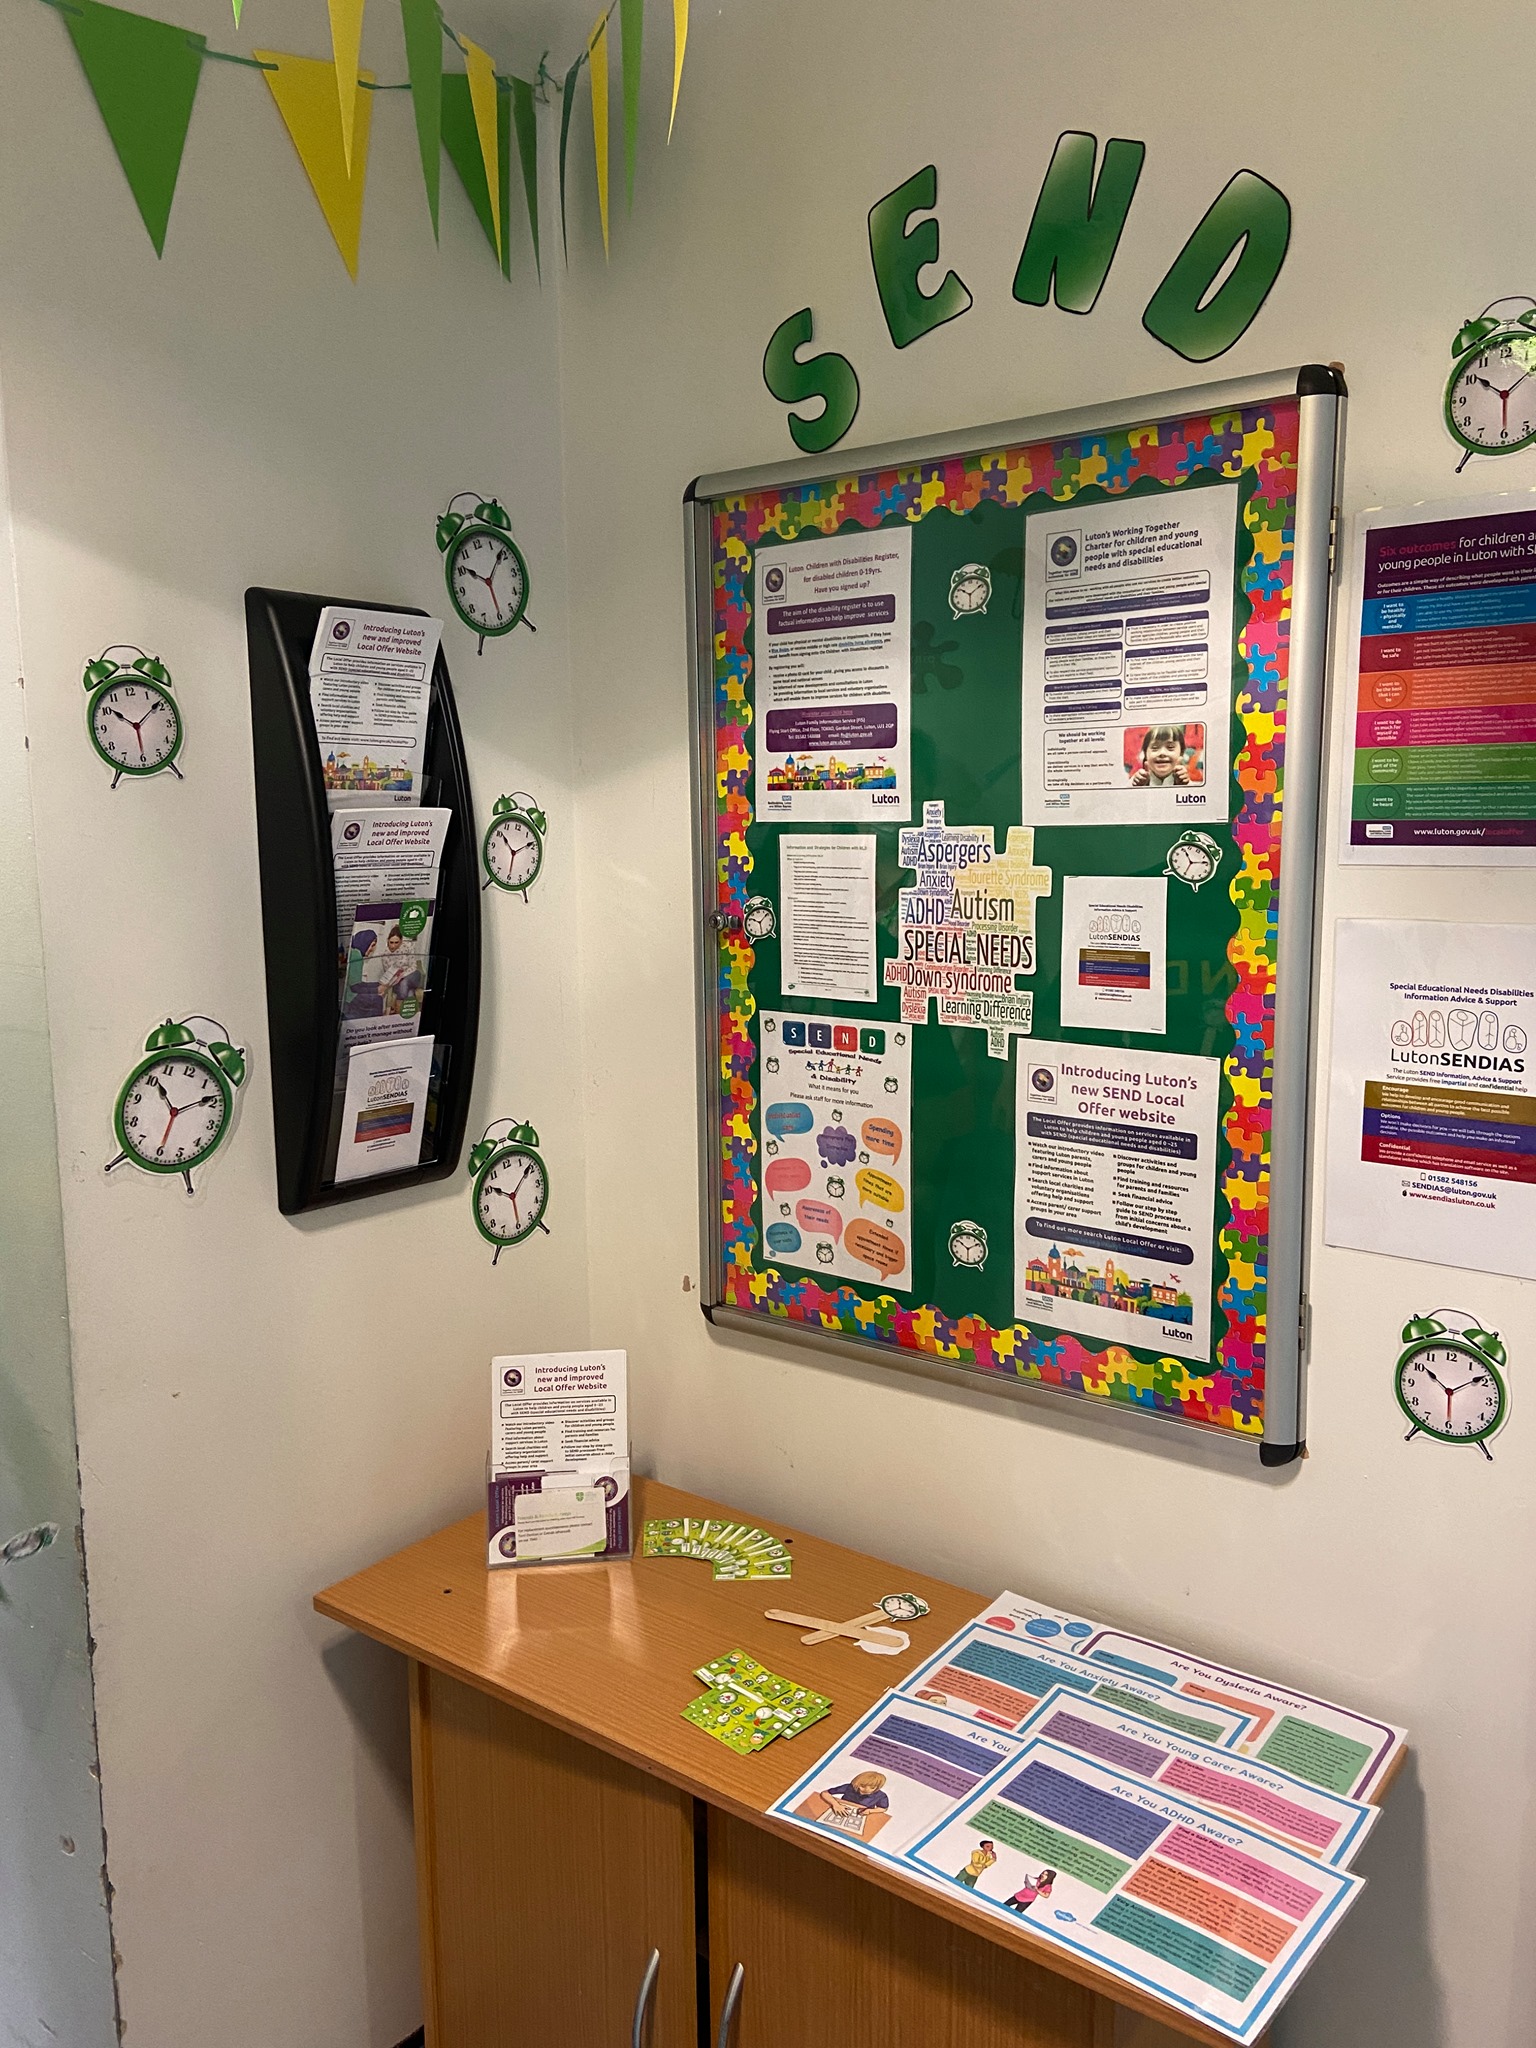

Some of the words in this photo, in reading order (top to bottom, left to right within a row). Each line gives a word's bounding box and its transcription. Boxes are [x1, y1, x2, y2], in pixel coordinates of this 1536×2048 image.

[763, 130, 1291, 454] SEND
[1085, 530, 1111, 541] Luton's
[1113, 526, 1143, 538] Working
[1145, 522, 1180, 533] Together
[1085, 540, 1112, 551] Charter
[1114, 538, 1124, 548] for
[1126, 534, 1157, 545] children
[1159, 532, 1172, 541] and
[1174, 529, 1198, 540] young
[1085, 551, 1109, 563] people
[1111, 546, 1127, 558] with
[1129, 543, 1155, 557] special
[1157, 539, 1202, 551] educational
[1379, 547, 1396, 557] Six
[1399, 541, 1456, 555] outcomes
[1459, 536, 1477, 548] for
[1478, 532, 1525, 546] children
[1528, 532, 1536, 541] a
[806, 563, 828, 571] Children
[829, 560, 841, 568] with
[842, 555, 873, 565] Disabilities
[875, 553, 899, 561] Register,
[1085, 562, 1106, 572] needs
[1108, 559, 1121, 569] and
[1123, 555, 1163, 566] disabilities
[1378, 559, 1411, 573] young
[1413, 554, 1451, 568] people
[1453, 552, 1463, 563] in
[1466, 550, 1498, 562] Luton
[1499, 545, 1524, 558] with
[1527, 544, 1536, 555] S
[813, 572, 835, 581] disabled
[836, 570, 858, 579] children
[859, 567, 882, 577] 0-19yrs.
[814, 586, 828, 594] Have
[829, 585, 839, 593] you
[840, 582, 858, 592] signed
[860, 581, 870, 589] up?
[363, 624, 401, 636] Introducing
[403, 628, 425, 637] Luton's
[357, 643, 375, 651] Local
[376, 645, 394, 653] Offer
[396, 647, 421, 656] Website
[391, 637, 421, 647] improved
[872, 794, 899, 804] Luton
[1176, 794, 1206, 804] Luton
[918, 837, 991, 869] Aspergers
[920, 871, 955, 891] Anxiety
[968, 869, 1004, 885] Tourette
[1006, 872, 1049, 889] Syndrome
[906, 898, 945, 925] ADHD
[951, 888, 1014, 921] Autism
[905, 929, 971, 964] SPECIAL
[977, 934, 1032, 969] NEEDS
[885, 965, 907, 982] ADHD
[908, 963, 941, 987] Down
[946, 966, 1011, 995] syndrome
[904, 987, 926, 999] Autism
[1390, 982, 1416, 992] Special
[1418, 984, 1462, 993] Educational
[1464, 987, 1488, 995] Needs
[1490, 988, 1534, 998] Disabilities
[902, 1002, 926, 1014] Dyslexia
[941, 997, 981, 1020] Learning
[984, 1000, 1031, 1021] Difference
[1404, 993, 1448, 1002] Information
[1451, 996, 1476, 1004] Advice
[1485, 998, 1517, 1007] Support
[816, 1049, 855, 1059] Educational
[859, 1055, 882, 1065] Needs
[1391, 1048, 1525, 1073] LutonSENDIAS
[820, 1075, 857, 1085] Disability
[1061, 1063, 1141, 1085] Introducing
[1145, 1072, 1198, 1090] Luton's
[845, 1099, 873, 1109] information
[1071, 1084, 1098, 1096] new
[1103, 1087, 1142, 1101] SEND
[1147, 1091, 1185, 1107] Local
[1078, 1102, 1115, 1117] Offer
[1119, 1108, 1176, 1125] website
[1381, 1112, 1401, 1120] Options
[1379, 1142, 1410, 1151] Confidential
[1428, 1174, 1449, 1184] 01582
[1451, 1177, 1478, 1187] 548156
[1412, 1182, 1497, 1199] SENDIAS@luton.gov.uk
[1409, 1191, 1496, 1209] www.sendiasluton.co.uk
[1163, 1326, 1192, 1341] Luton
[535, 1366, 578, 1374] Introducing
[570, 1373, 604, 1382] improved
[577, 1382, 607, 1390] Website
[1037, 1653, 1057, 1664] Are
[1059, 1660, 1077, 1674] You
[1079, 1668, 1119, 1687] Anxiety
[1121, 1682, 1161, 1701] Aware?
[1170, 1660, 1190, 1672] Are
[1193, 1668, 1212, 1680] You
[1215, 1675, 1261, 1697] Dyslexia
[1264, 1691, 1307, 1711] Aware?
[967, 1731, 988, 1744] Are
[991, 1740, 1011, 1753] You
[1117, 1722, 1139, 1736] Are
[1141, 1731, 1162, 1745] You
[1166, 1740, 1200, 1761] Young
[1203, 1754, 1235, 1772] Carer
[1240, 1767, 1284, 1791] Aware?
[1111, 1785, 1133, 1799] Are
[1136, 1794, 1158, 1809] You
[1160, 1806, 1196, 1826] ADHD
[1198, 1821, 1244, 1847] Aware?
